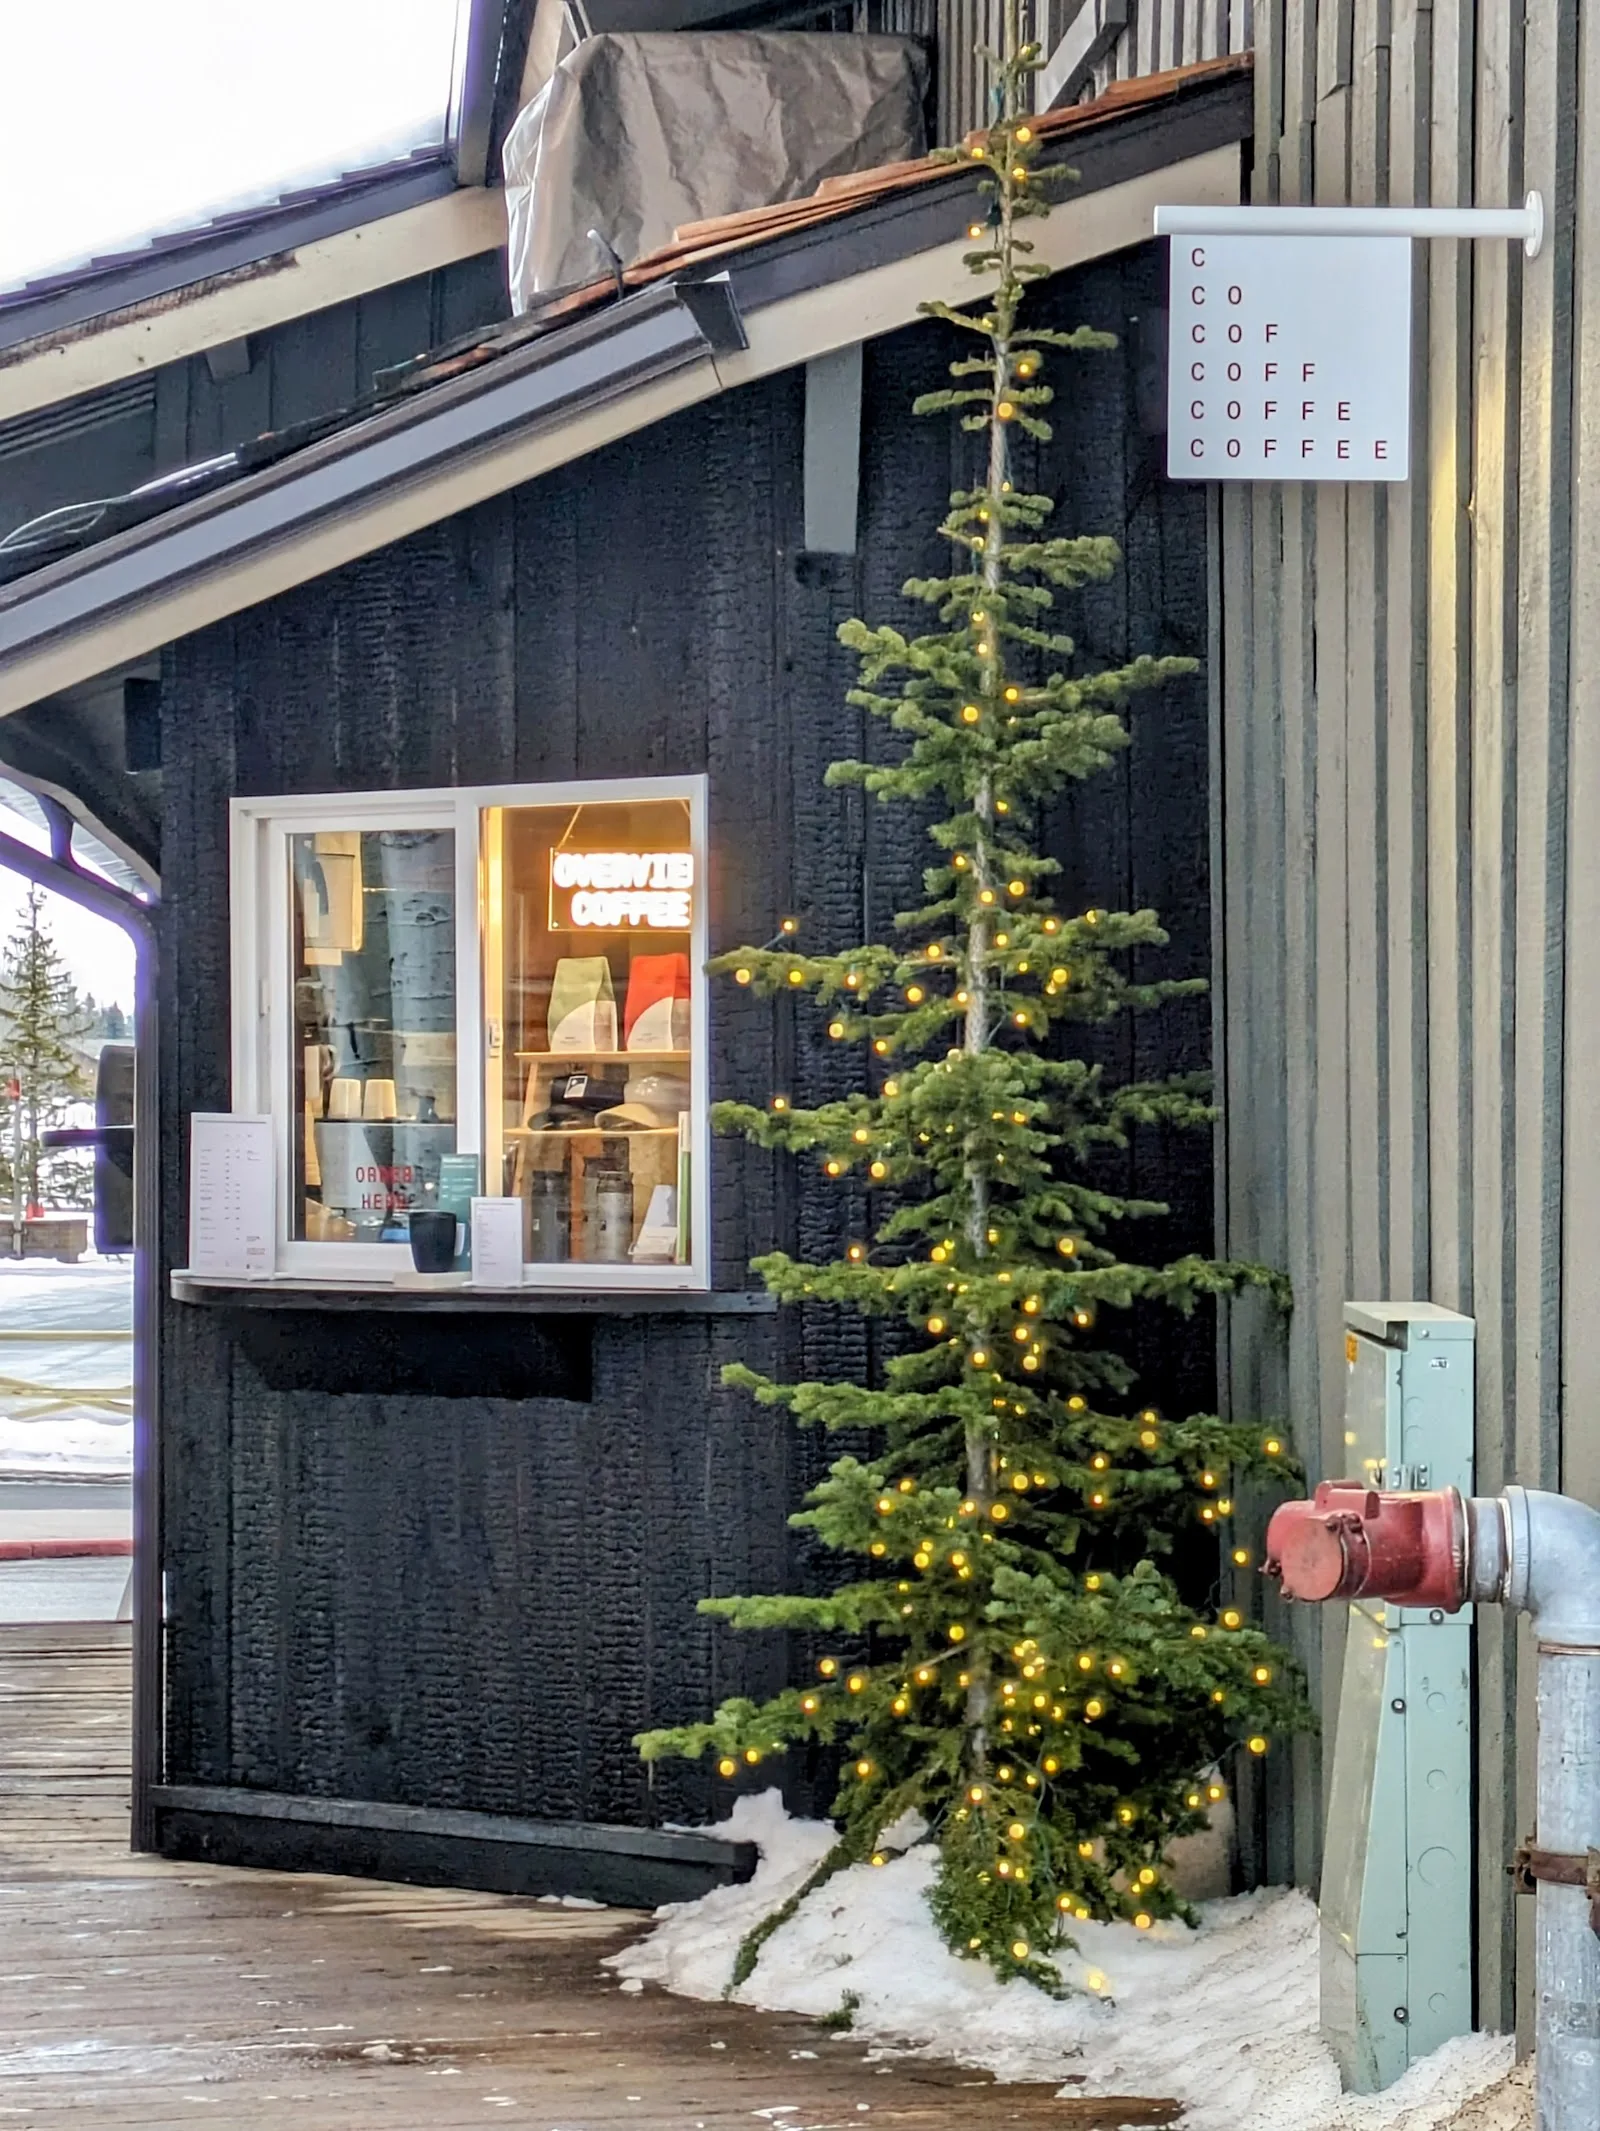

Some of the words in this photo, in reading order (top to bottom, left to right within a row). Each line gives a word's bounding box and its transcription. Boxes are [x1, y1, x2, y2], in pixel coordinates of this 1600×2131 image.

[1191, 248, 1206, 267] C
[1191, 362, 1316, 382] COFF
[1190, 400, 1351, 421] COFFE
[1190, 438, 1388, 459] COFFEE
[571, 891, 692, 927] COFFEE
